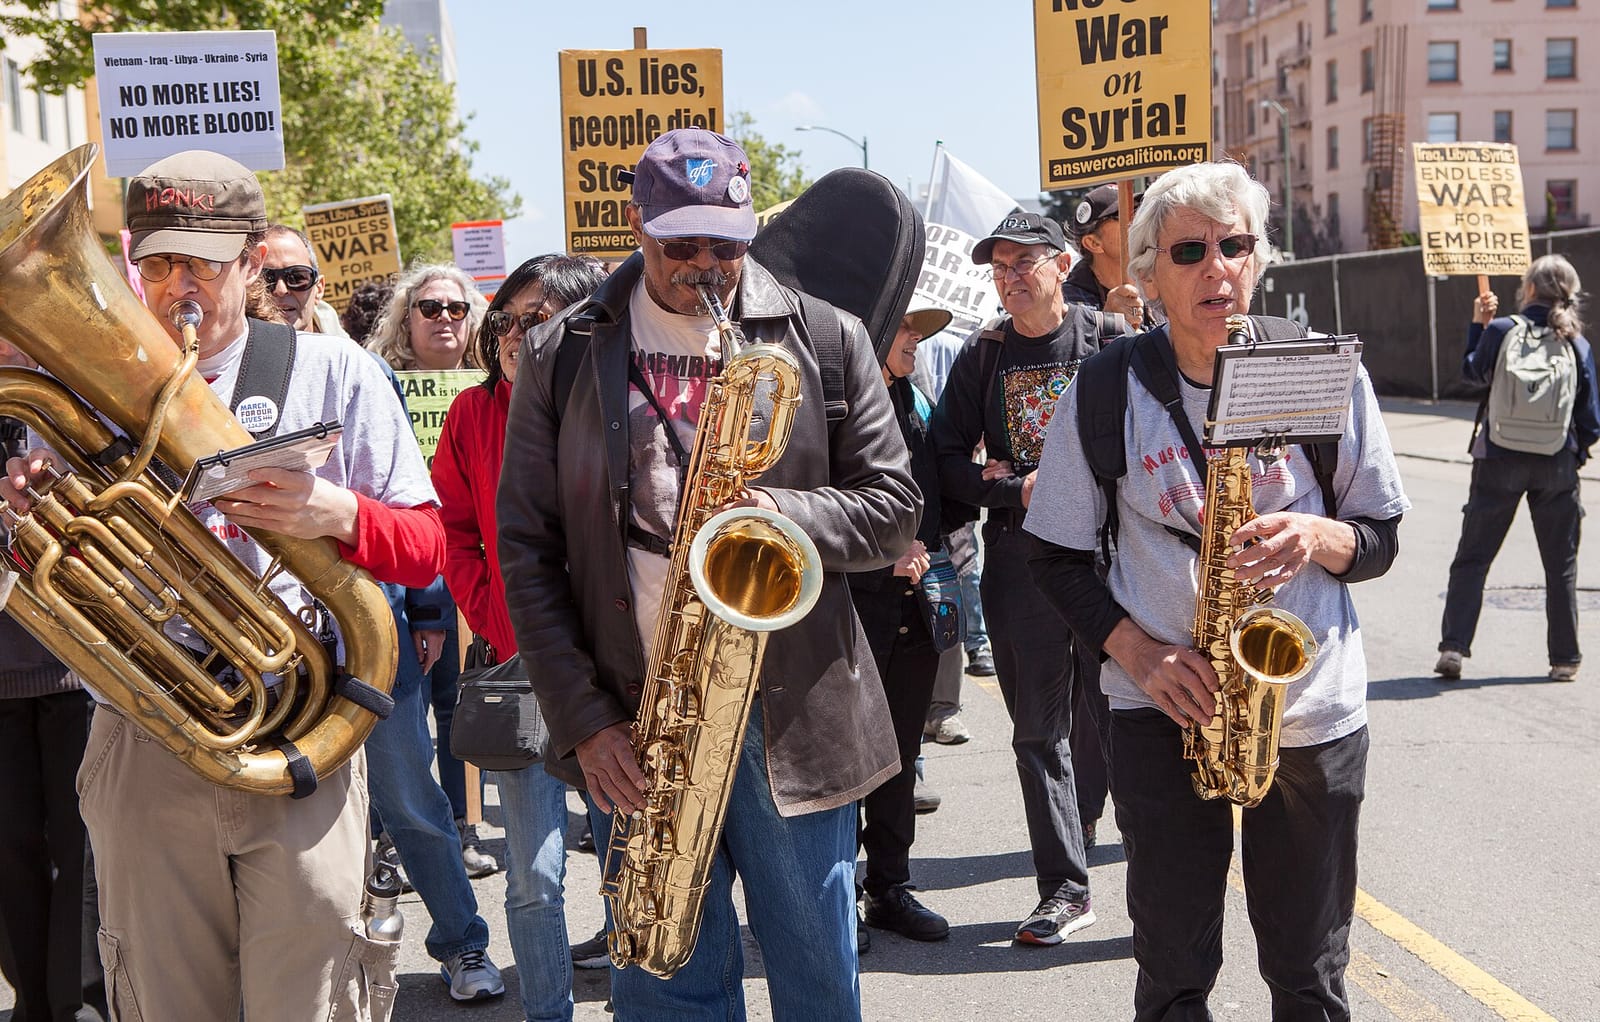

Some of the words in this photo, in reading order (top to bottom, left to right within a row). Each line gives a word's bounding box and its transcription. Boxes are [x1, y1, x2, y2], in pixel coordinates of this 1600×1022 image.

[1075, 13, 1169, 65] War
[104, 57, 143, 67] Vietnam
[150, 56, 168, 66] Iraq
[174, 54, 198, 65] Libya
[204, 53, 239, 64] Ukraine
[245, 52, 268, 63] Syria
[577, 57, 633, 97] U.S.
[639, 57, 705, 98] lies,
[1103, 70, 1143, 97] on
[119, 85, 147, 107] NO
[152, 82, 209, 105] MORE
[213, 80, 261, 103] LIES!
[110, 117, 137, 139] NO
[143, 114, 200, 137] MORE
[204, 111, 275, 134] BLOOD!
[569, 108, 661, 151] people
[1061, 94, 1187, 151] Syria!
[690, 160, 718, 184] aft
[1052, 147, 1204, 176] answercoalition.org
[1421, 167, 1515, 181] ENDLESS
[145, 186, 215, 212] HONK!
[1428, 183, 1513, 207] WAR
[311, 218, 389, 242] ENDLESS
[1455, 213, 1494, 226] FOR
[926, 225, 960, 246] OP
[1427, 232, 1525, 249] EMPIRE
[317, 233, 388, 263] WAR
[925, 245, 963, 275] AR
[340, 261, 373, 276] FOR
[917, 270, 986, 312] RIA!
[402, 379, 436, 397] AR
[439, 388, 447, 396] is
[240, 402, 267, 411] MARCH
[257, 408, 272, 416] OUR
[241, 416, 262, 424] LIVES
